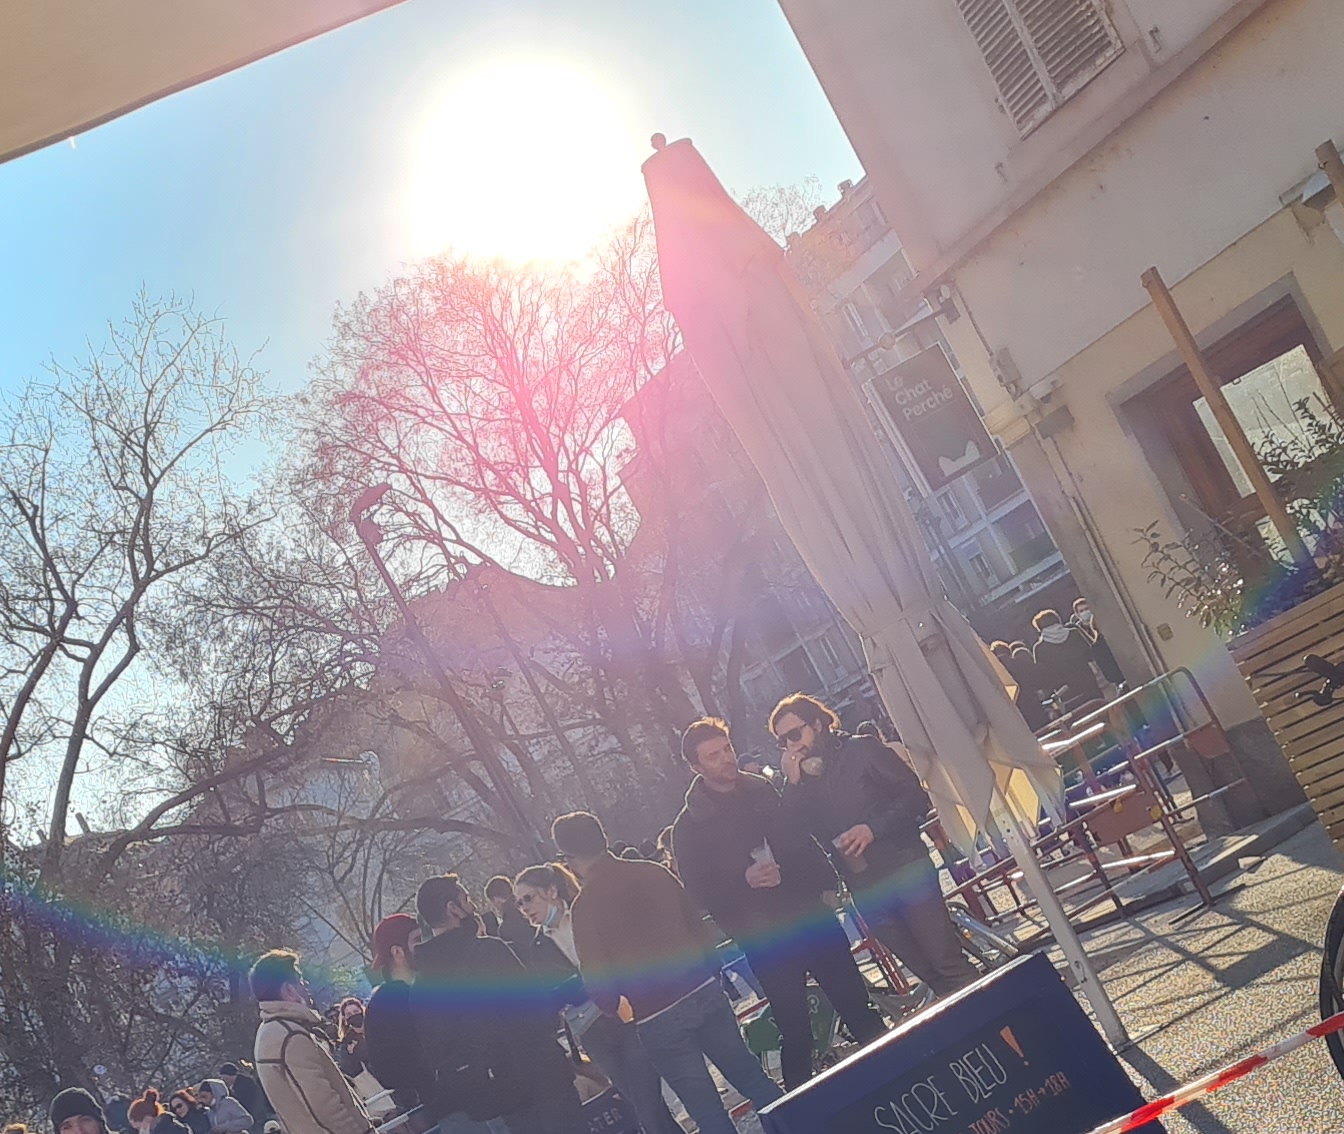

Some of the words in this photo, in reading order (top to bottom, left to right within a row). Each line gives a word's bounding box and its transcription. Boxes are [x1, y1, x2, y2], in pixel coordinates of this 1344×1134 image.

[886, 376, 904, 391] Le
[896, 379, 932, 405] Chat
[902, 384, 953, 421] Perché
[949, 1043, 1007, 1103] BLEU
